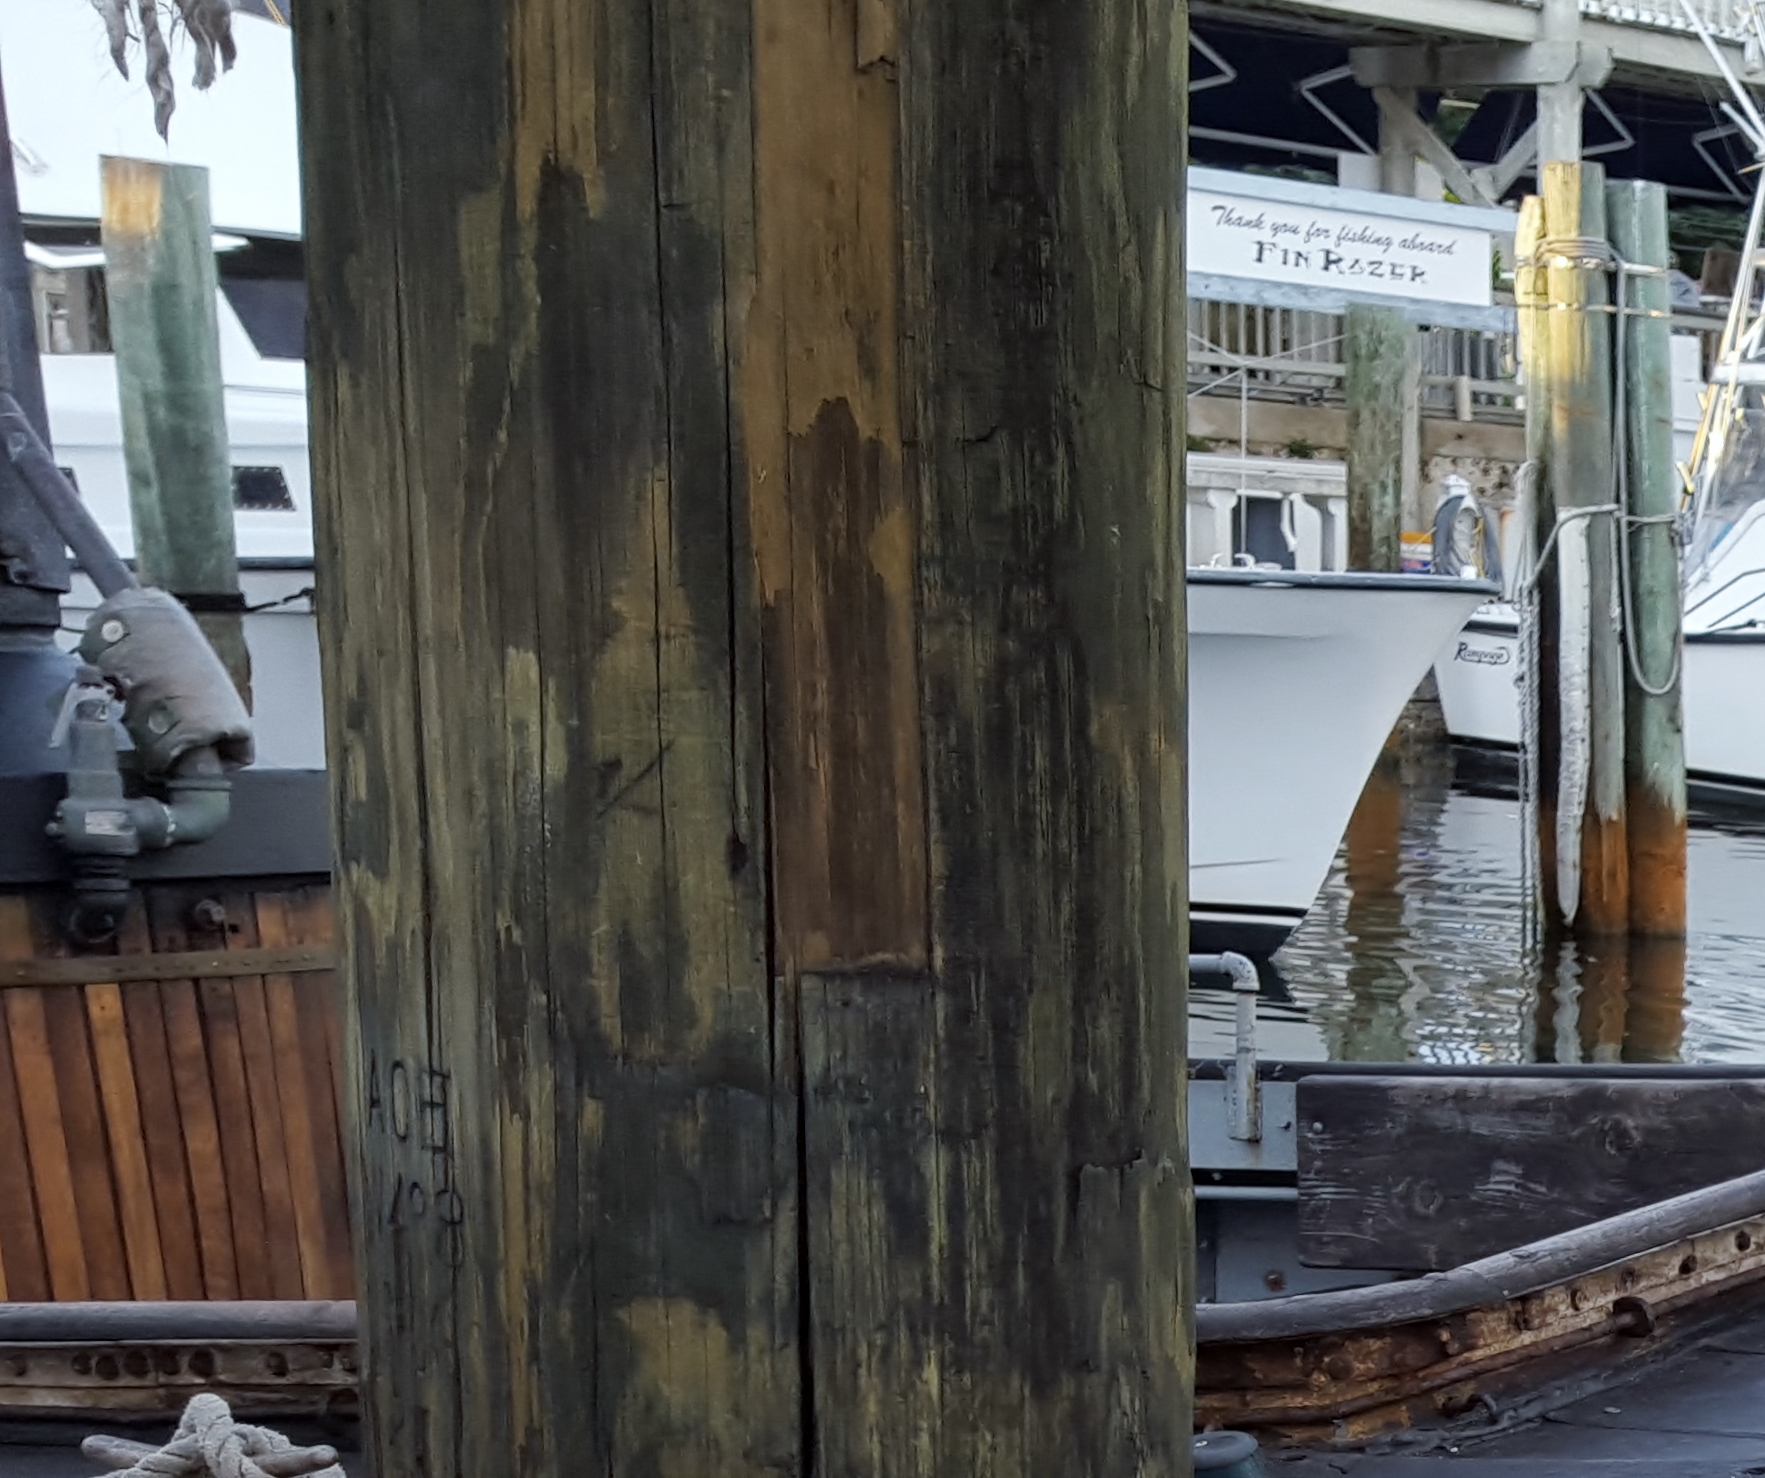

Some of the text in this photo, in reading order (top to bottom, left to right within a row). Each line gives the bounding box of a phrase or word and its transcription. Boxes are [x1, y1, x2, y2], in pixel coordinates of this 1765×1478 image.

[1211, 205, 1457, 256] Thank you for fishing aboard
